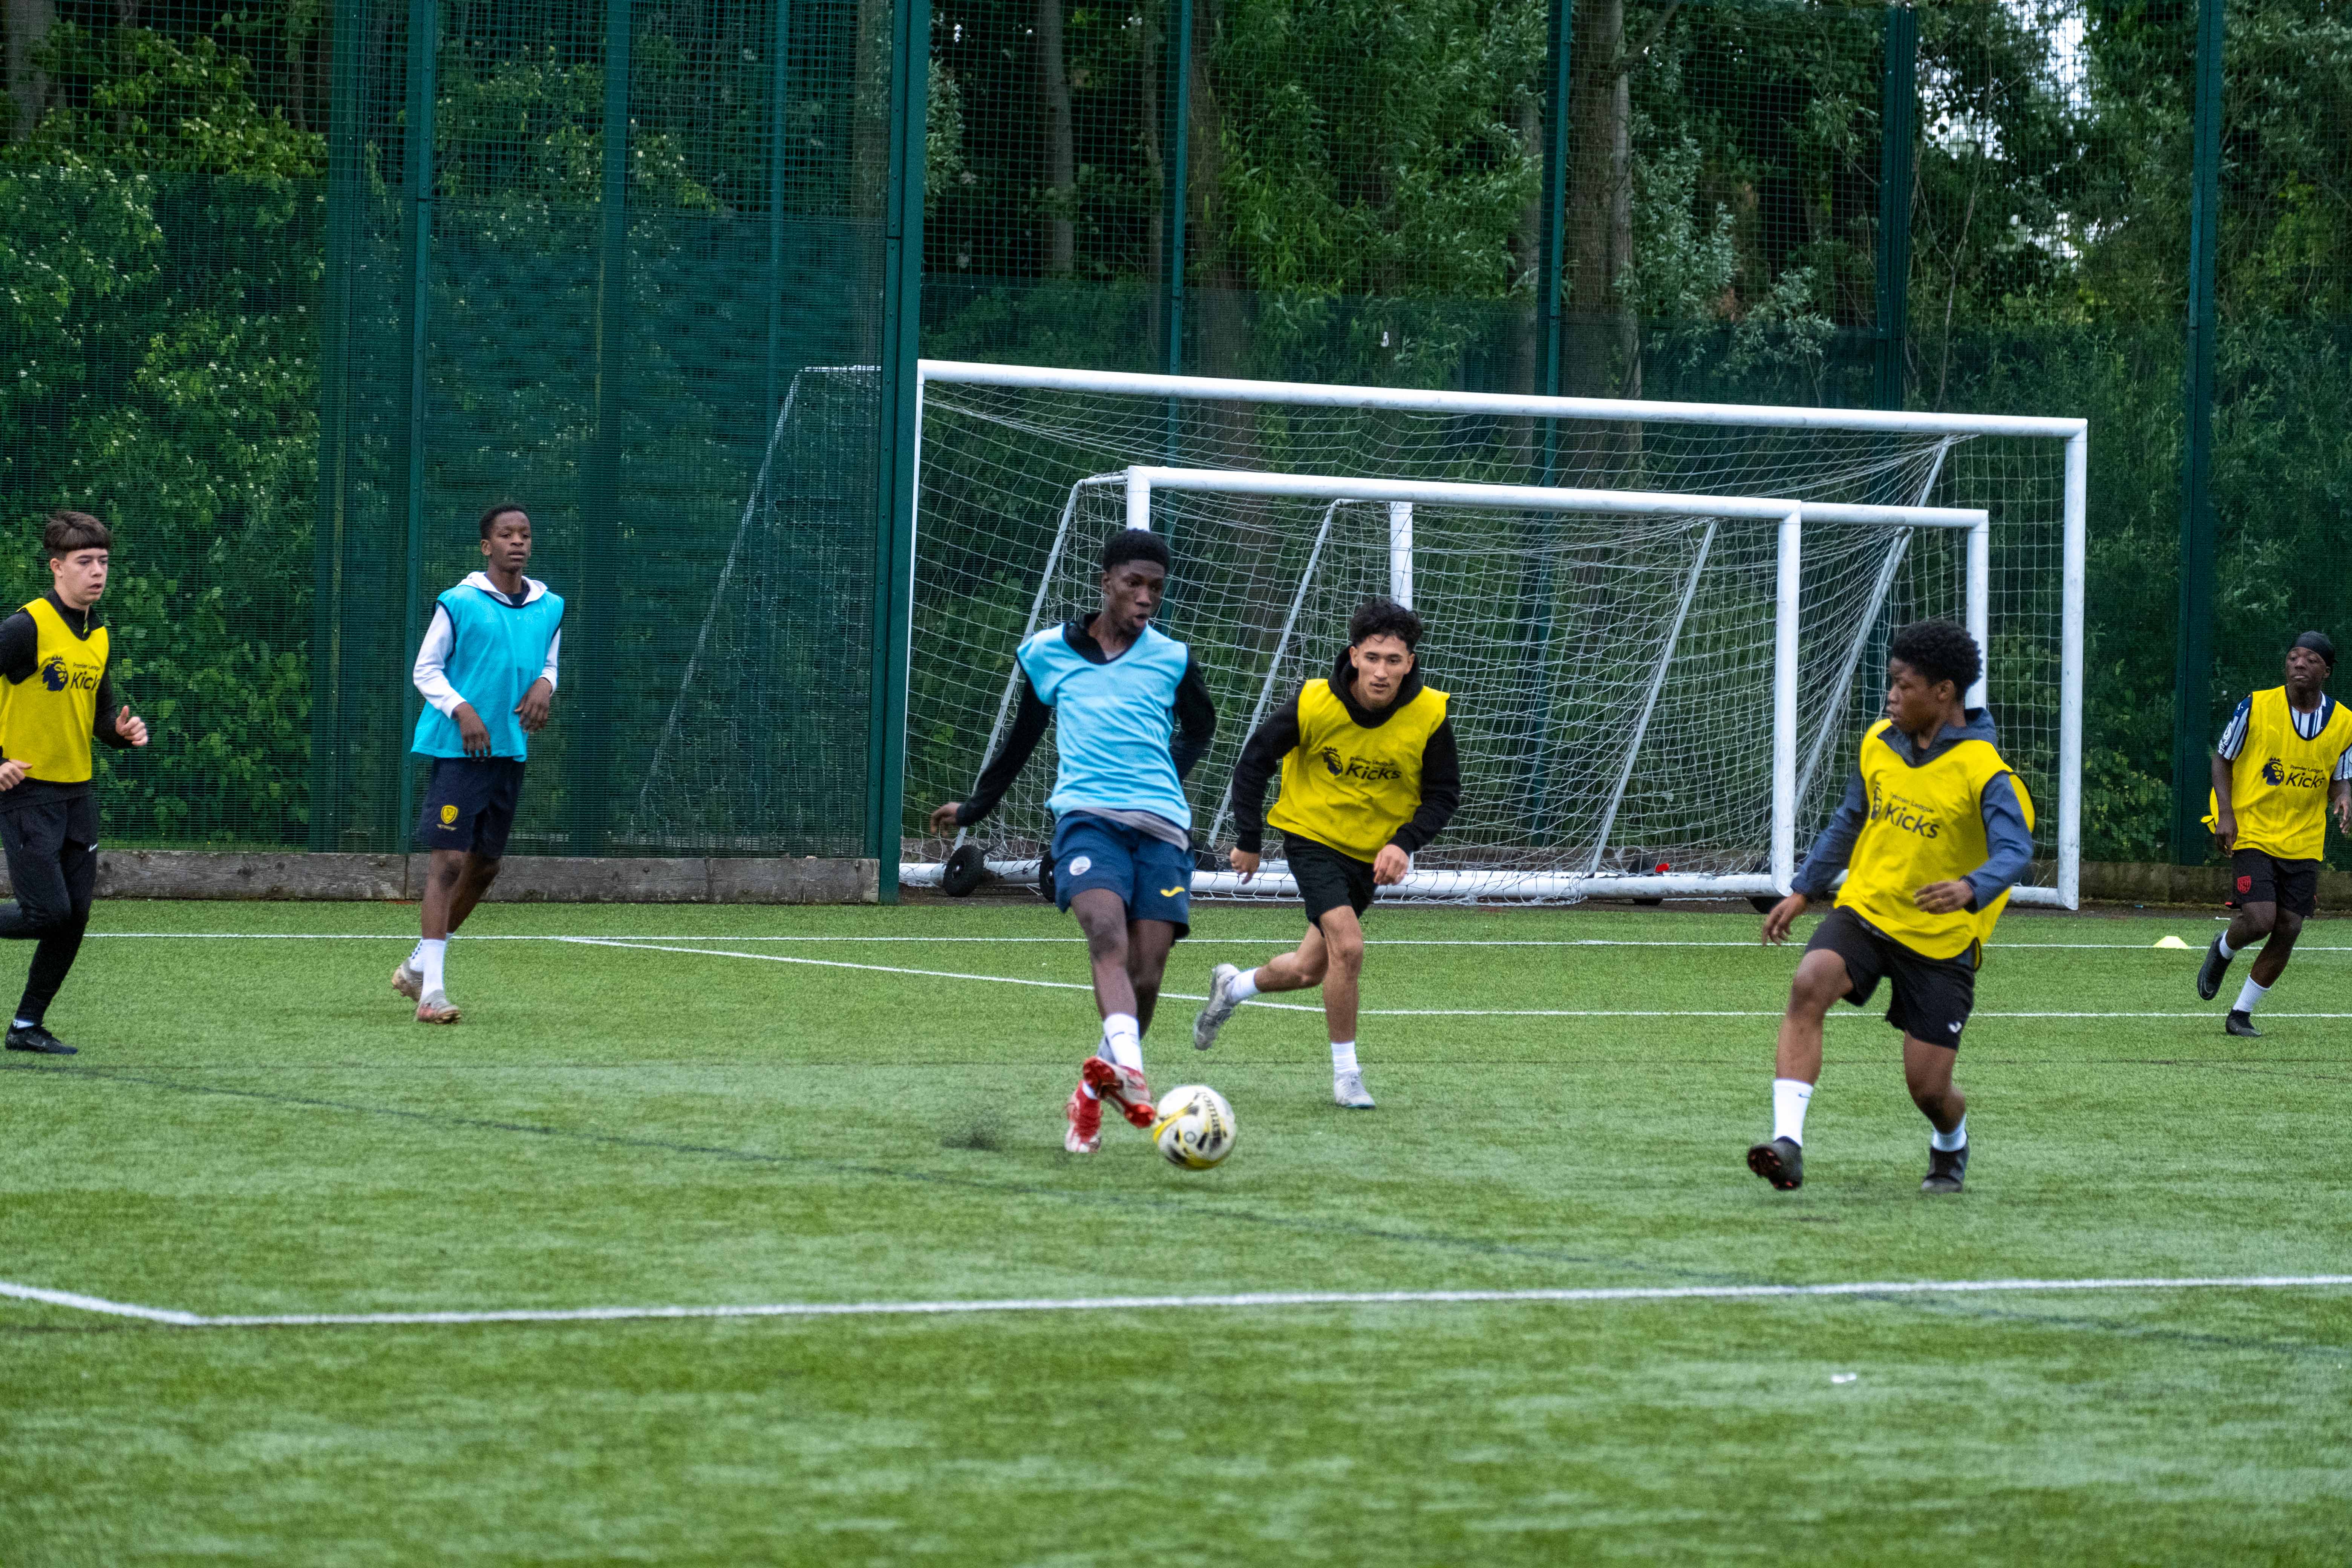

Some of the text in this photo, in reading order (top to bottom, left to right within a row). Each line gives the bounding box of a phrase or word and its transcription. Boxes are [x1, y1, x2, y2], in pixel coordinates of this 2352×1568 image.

[70, 671, 100, 691] Kick
[1345, 763, 1402, 780] Kicks
[1911, 800, 1934, 813] League
[1885, 802, 1940, 839] Kicks
